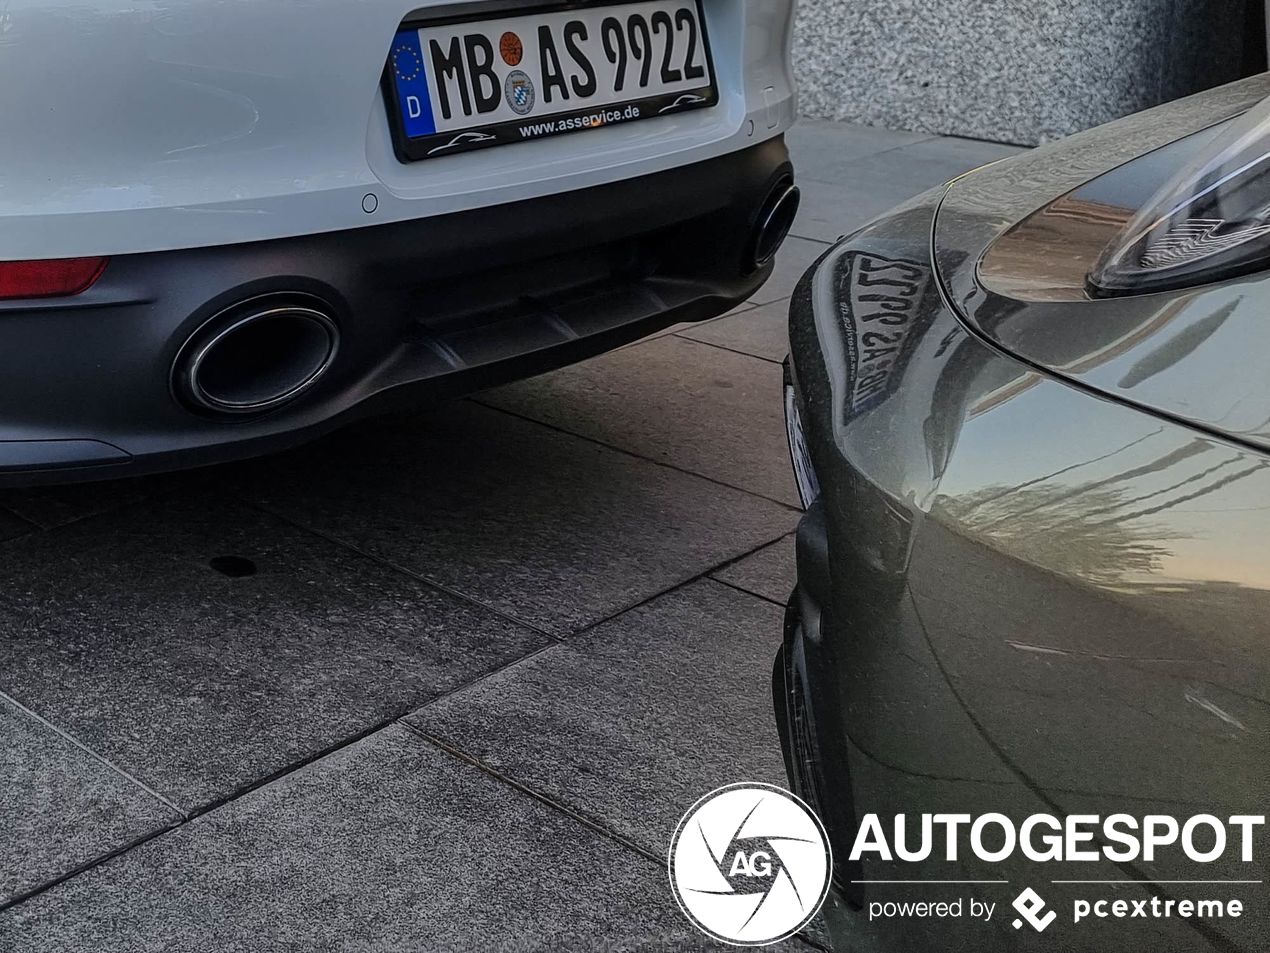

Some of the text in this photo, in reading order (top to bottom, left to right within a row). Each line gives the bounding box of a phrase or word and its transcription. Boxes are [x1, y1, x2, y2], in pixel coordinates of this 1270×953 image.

[407, 96, 422, 118] D
[430, 33, 502, 119] MB
[537, 20, 597, 103] AS
[601, 8, 704, 92] 9922
[519, 106, 640, 138] www.asservice.de
